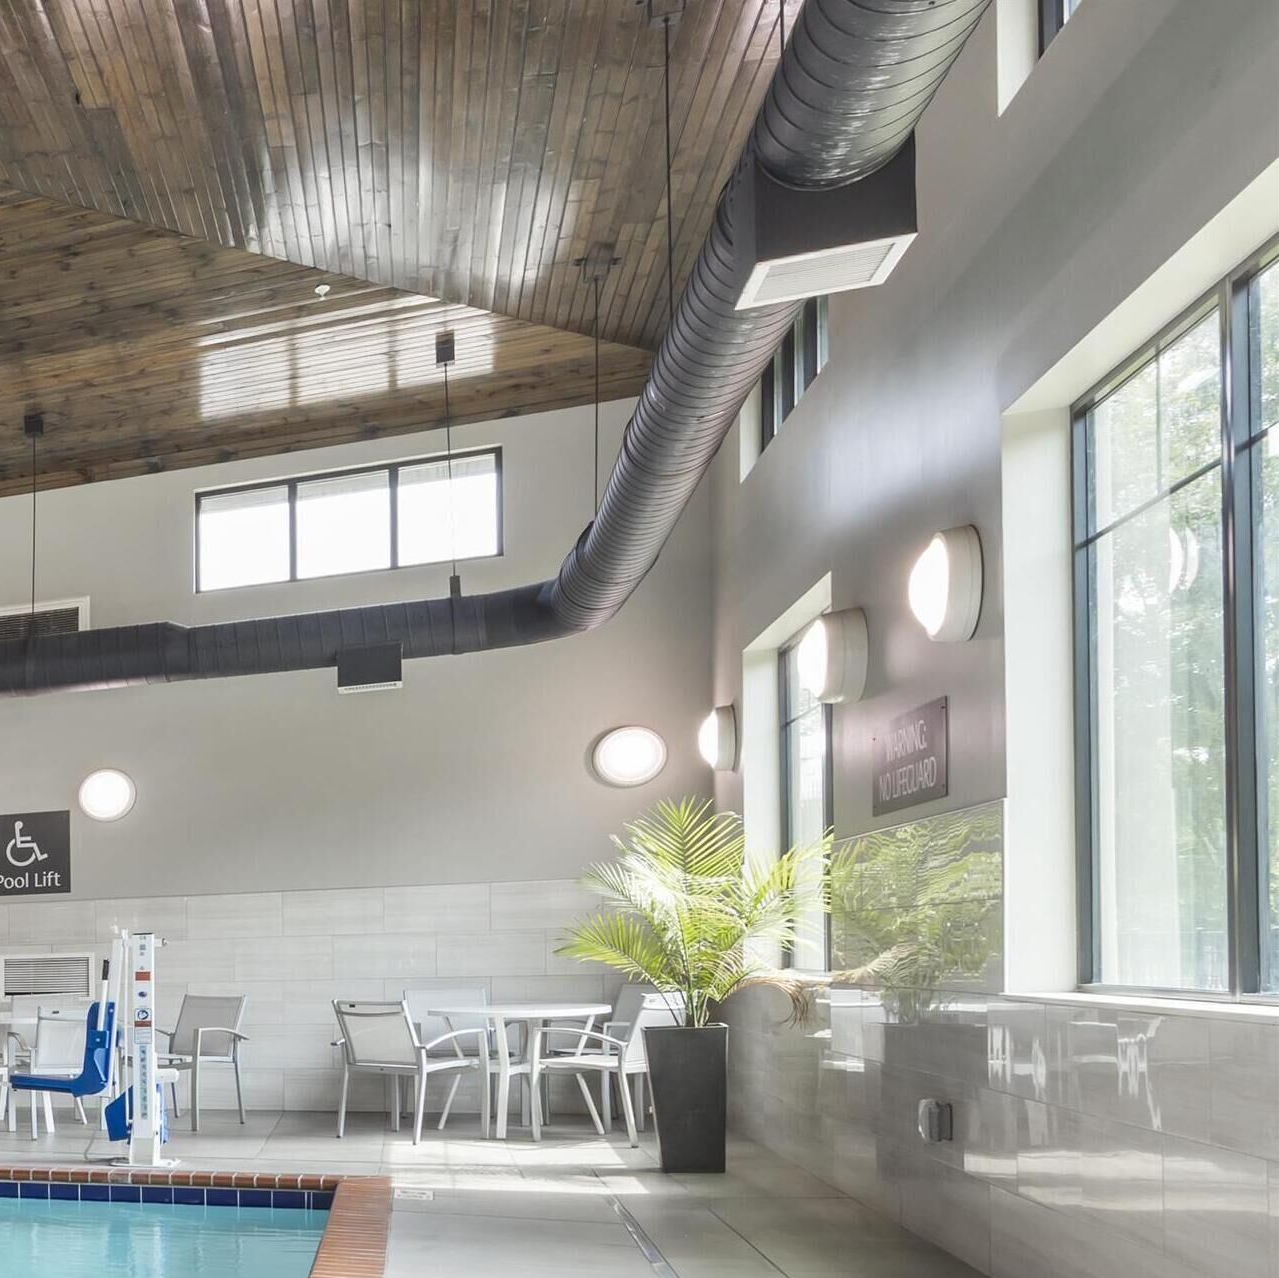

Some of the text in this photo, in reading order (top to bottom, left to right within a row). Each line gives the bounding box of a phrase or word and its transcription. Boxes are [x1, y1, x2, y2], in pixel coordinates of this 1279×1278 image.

[884, 720, 927, 762] WARNING:
[879, 756, 937, 803] NO LIFEGUARD
[34, 871, 62, 888] Lift
